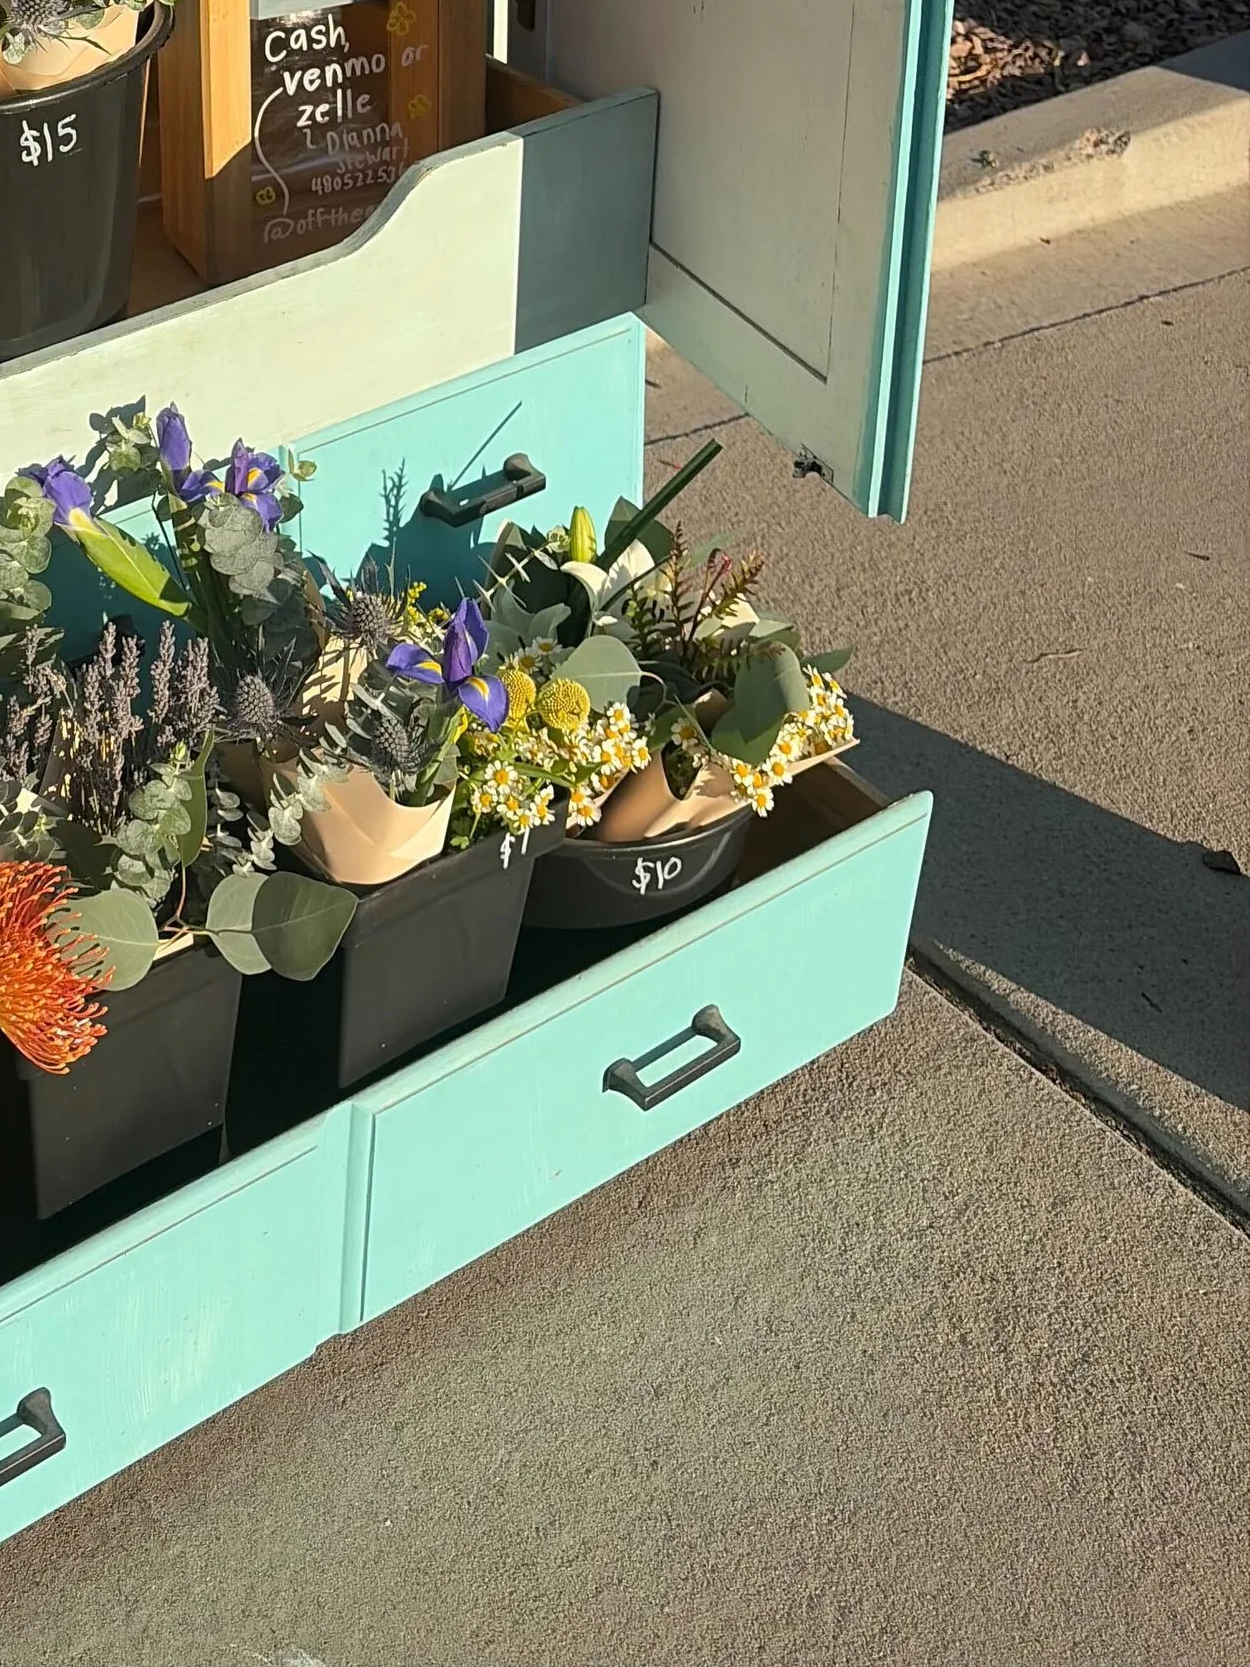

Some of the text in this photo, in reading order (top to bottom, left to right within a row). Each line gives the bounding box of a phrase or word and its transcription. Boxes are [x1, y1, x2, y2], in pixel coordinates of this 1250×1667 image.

[282, 44, 429, 96] venmo or
[296, 88, 373, 127] zelle
[19, 113, 78, 167] $15
[631, 856, 682, 895] $10
